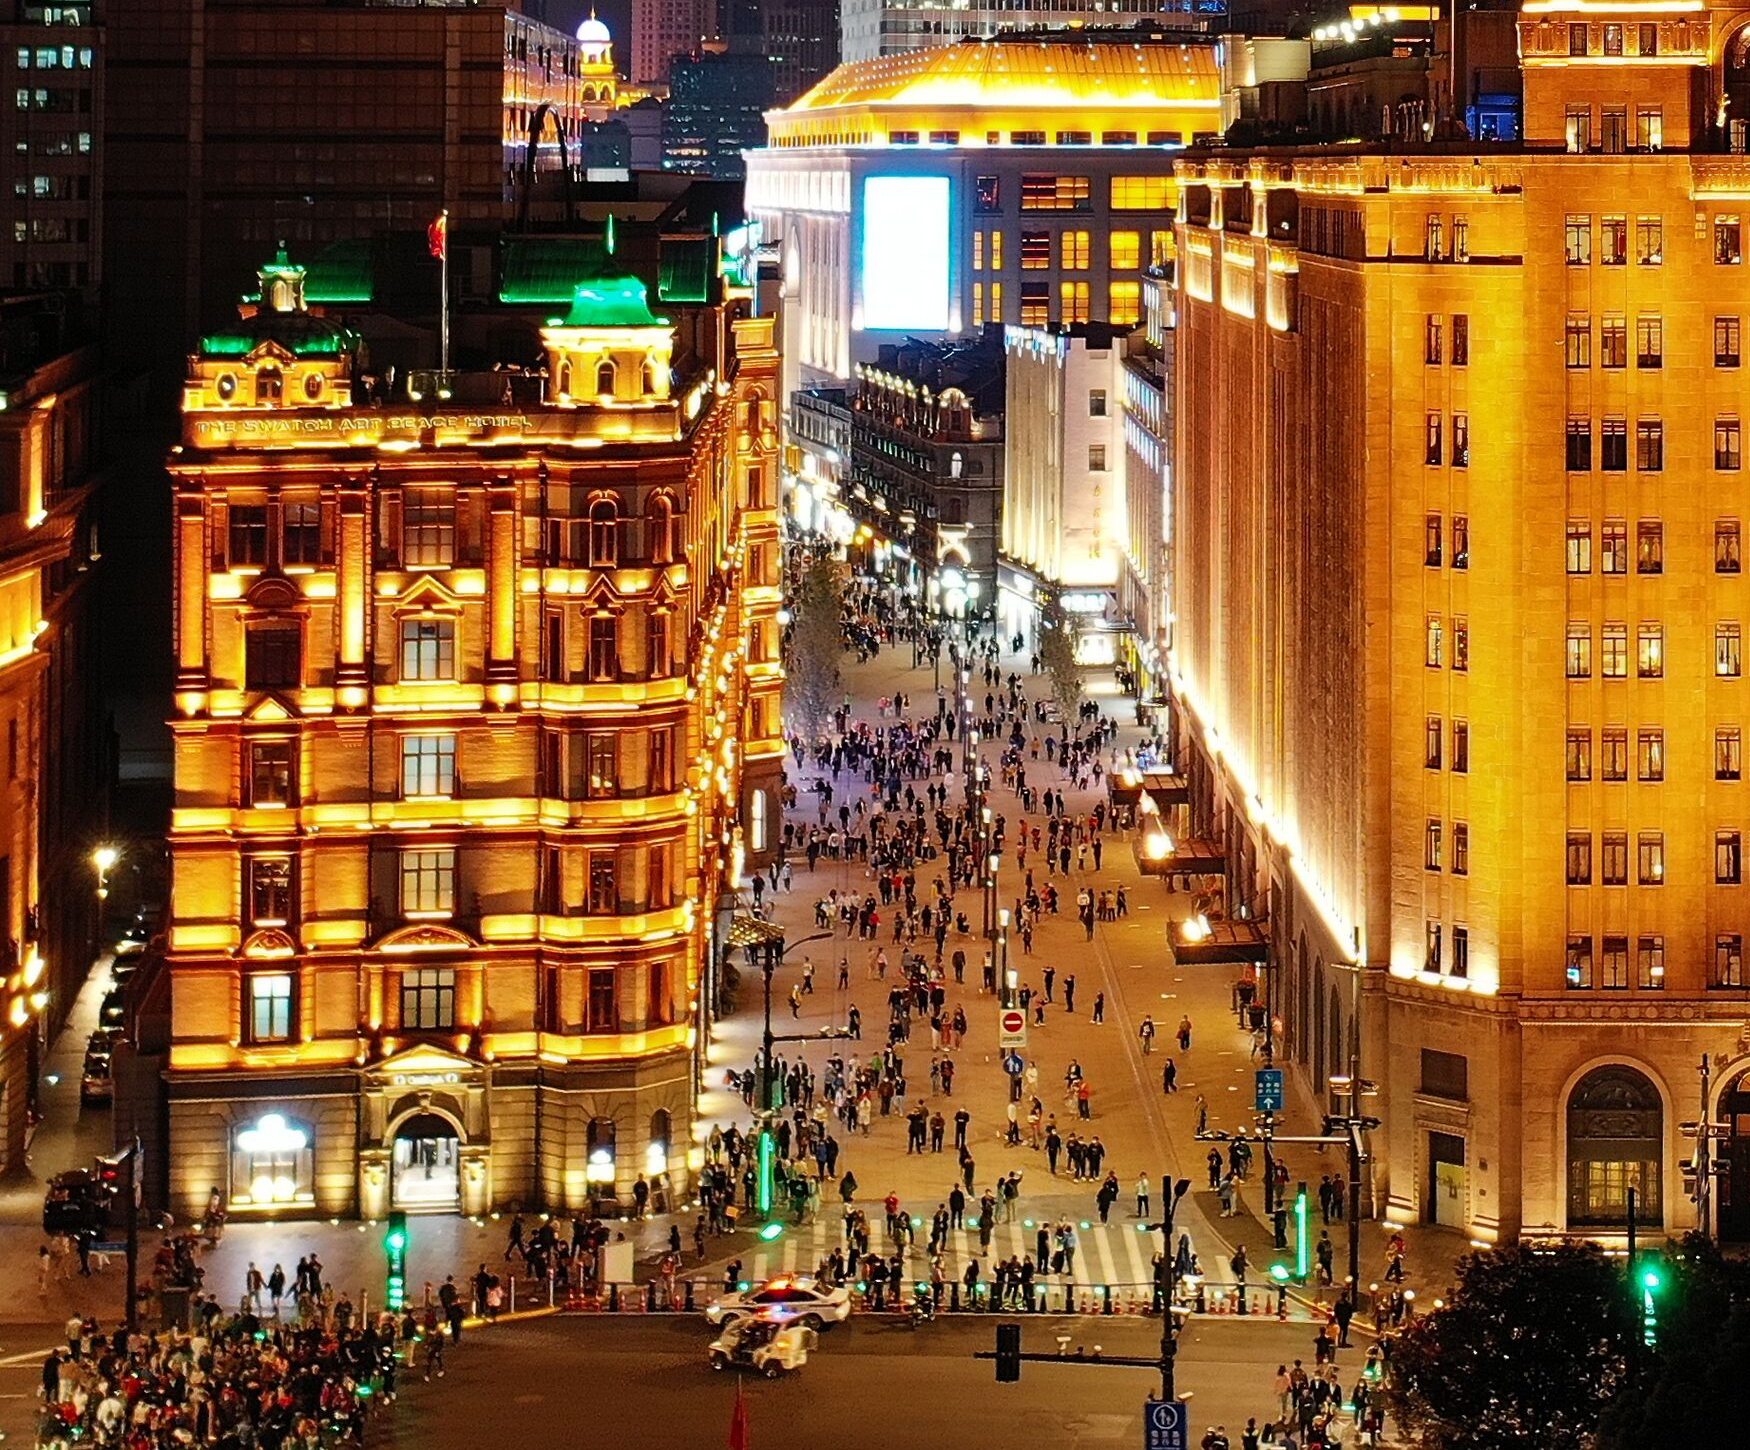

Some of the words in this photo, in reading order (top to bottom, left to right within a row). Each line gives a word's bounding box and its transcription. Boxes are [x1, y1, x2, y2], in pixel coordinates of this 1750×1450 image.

[195, 420, 237, 434] THE
[243, 418, 333, 433] SWATCH
[339, 416, 383, 432] ART
[464, 414, 533, 429] HOTEL
